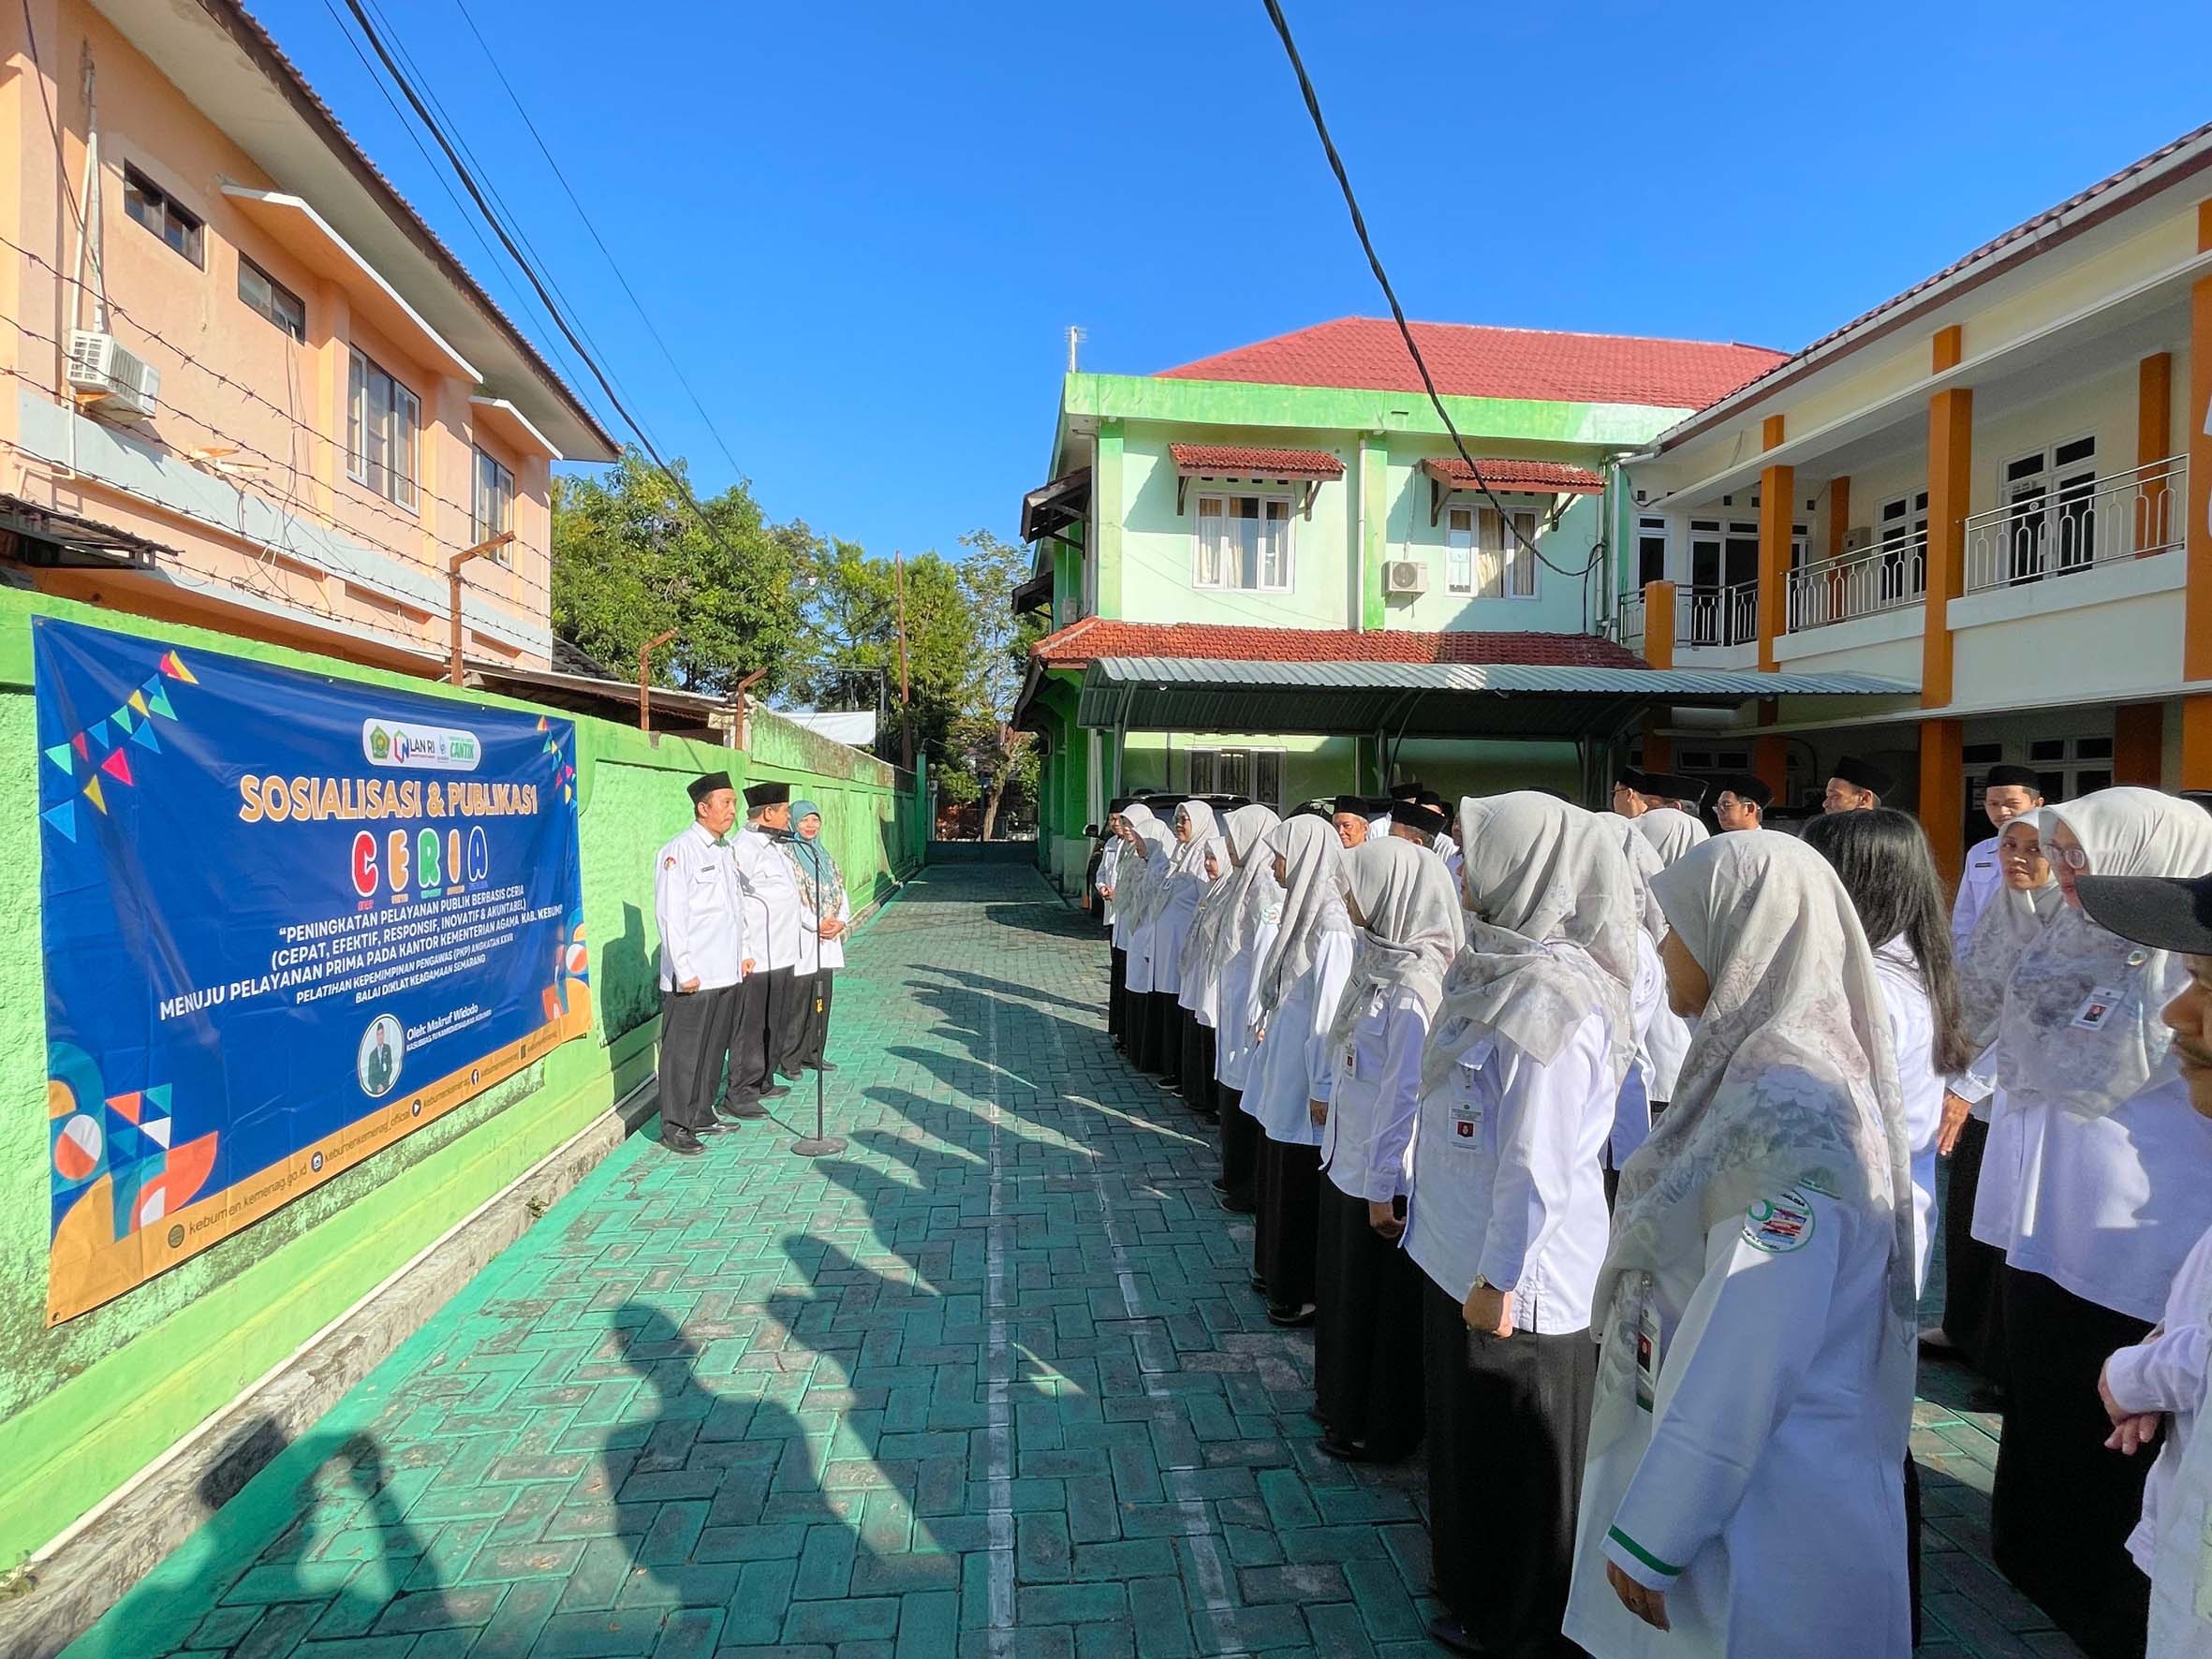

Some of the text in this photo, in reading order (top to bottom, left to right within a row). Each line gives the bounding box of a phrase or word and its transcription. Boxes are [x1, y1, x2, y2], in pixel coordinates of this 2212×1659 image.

[410, 738, 435, 754] LAN RI
[239, 774, 538, 823] SOSIALISASI & PUBLIKASI
[351, 825, 489, 898] CERIA
[380, 901, 440, 925] PELAYANAN
[441, 895, 471, 913] PUBLIK
[471, 888, 506, 906] BERBASIS
[506, 885, 524, 899] CERIA
[272, 898, 526, 972] (CEPAT, EFEKTIF, RESPONSIF, INOVATIF & AKUNTABEL)
[159, 985, 226, 1021] MENUJU
[229, 963, 323, 1001] PELAYANAN
[326, 954, 364, 977] PRIMA
[366, 946, 398, 965] PADA
[399, 935, 439, 959] KANTOR
[440, 921, 495, 947] KEMENTERIAN
[495, 915, 520, 932] AGAMA
[522, 911, 538, 923] KAB.
[296, 978, 352, 1005] PELATIHAN
[353, 962, 415, 989] KEPEMIMPINAN
[415, 949, 453, 971] PENGAWAS
[453, 945, 471, 961] (PKP)
[471, 937, 500, 953] ANGKATAN
[355, 954, 486, 1005] BALAI DIKLAT KEAGAMAAN SEMARANG
[406, 1024, 427, 1041] Oleh:
